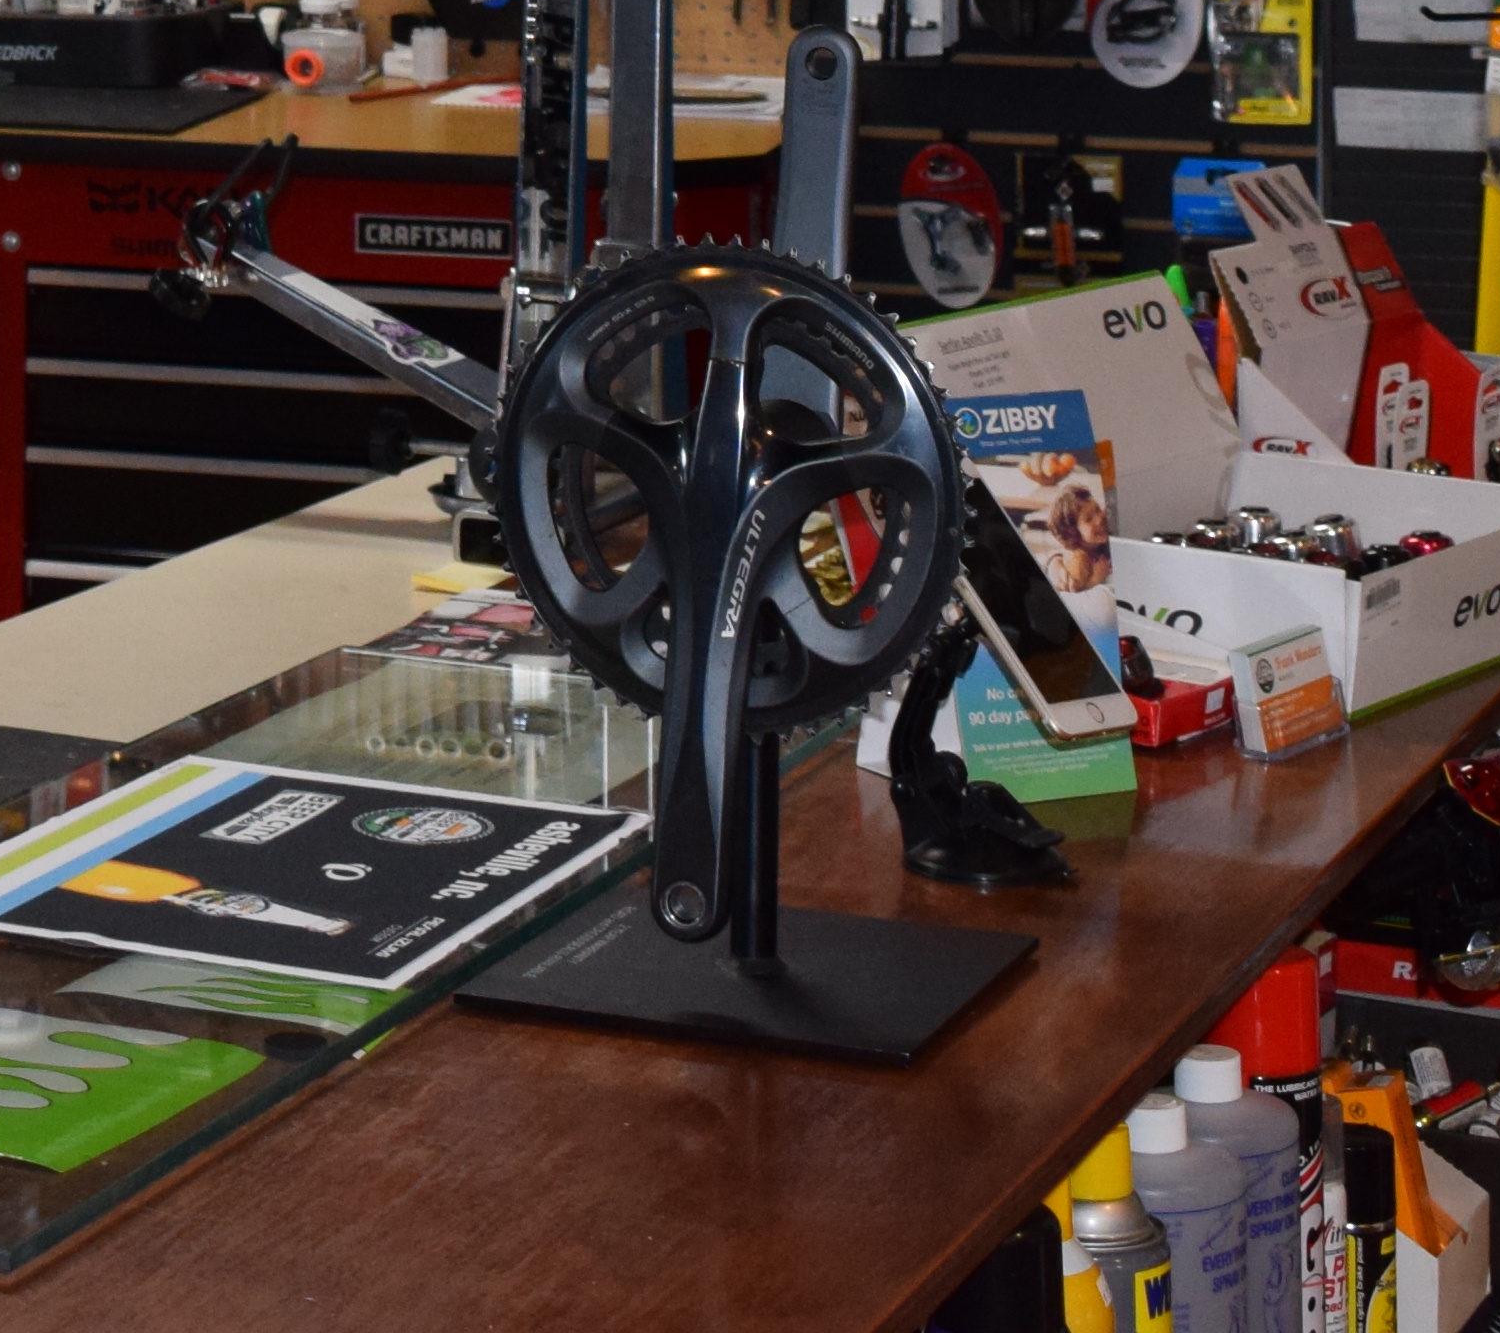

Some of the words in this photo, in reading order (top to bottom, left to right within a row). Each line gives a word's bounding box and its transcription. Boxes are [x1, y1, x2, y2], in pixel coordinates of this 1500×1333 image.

[364, 223, 505, 252] CRAFTSMAN
[1103, 300, 1167, 338] evo
[822, 319, 875, 371] SHIMANO
[981, 404, 1058, 436] ZIBBY
[719, 509, 764, 642] ULTEGRA
[986, 688, 1004, 701] No
[968, 710, 987, 726] 90
[988, 708, 1011, 727] day
[274, 794, 339, 818] BEER
[235, 818, 295, 839] CITY
[471, 819, 582, 879] asheville,
[430, 874, 490, 902] nc.
[1254, 1083, 1274, 1094] THE
